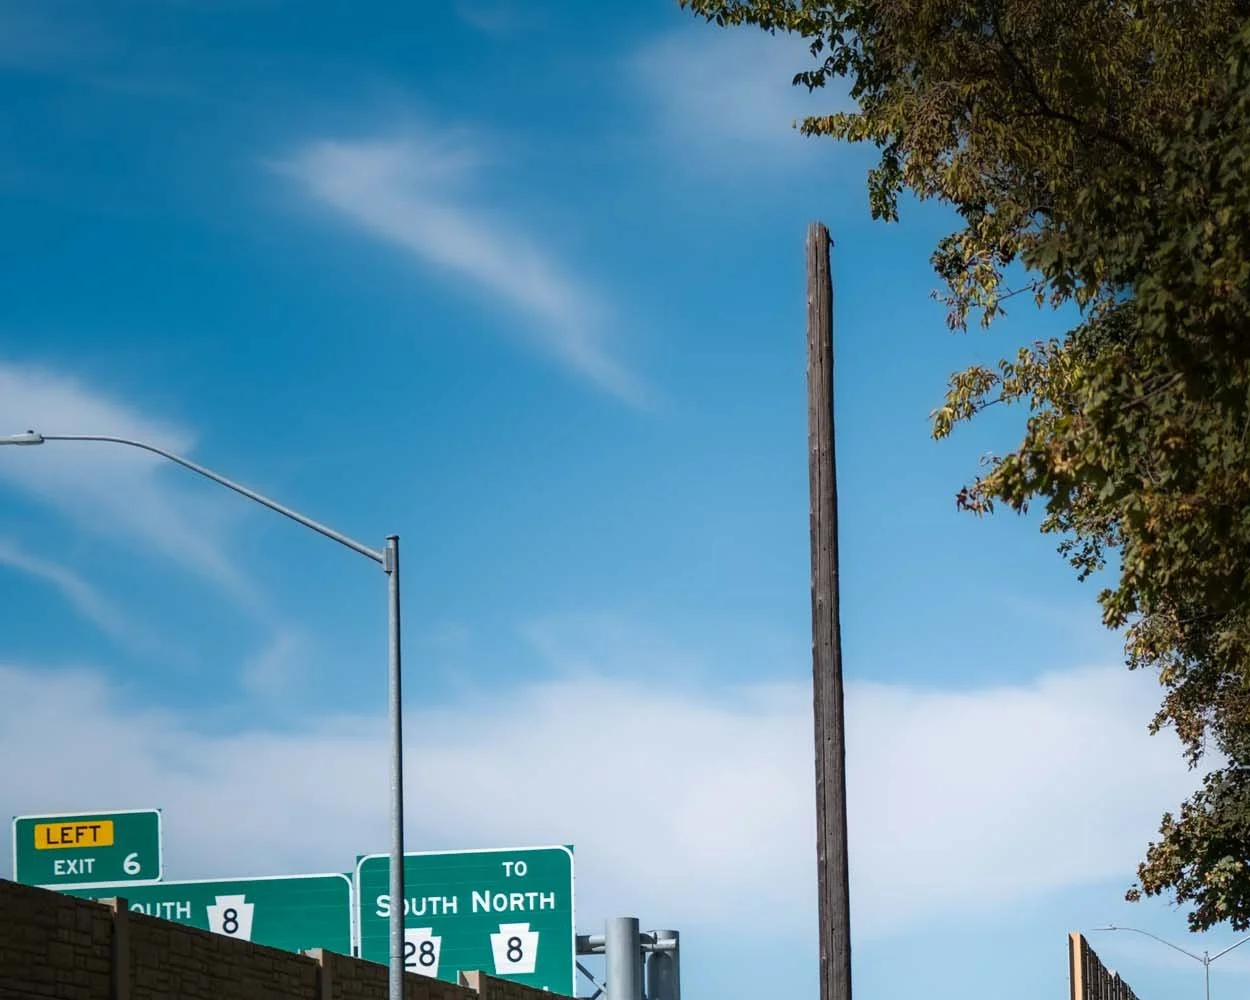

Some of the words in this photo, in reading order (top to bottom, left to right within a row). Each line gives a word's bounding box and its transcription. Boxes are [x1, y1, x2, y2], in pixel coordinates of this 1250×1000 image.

[46, 825, 102, 845] LEFT
[53, 858, 96, 876] EXIT
[123, 852, 141, 876] 6
[502, 861, 527, 877] TO
[471, 890, 556, 913] NORTH
[223, 908, 239, 934] 8
[404, 940, 435, 968] 28
[506, 936, 523, 963] 8
